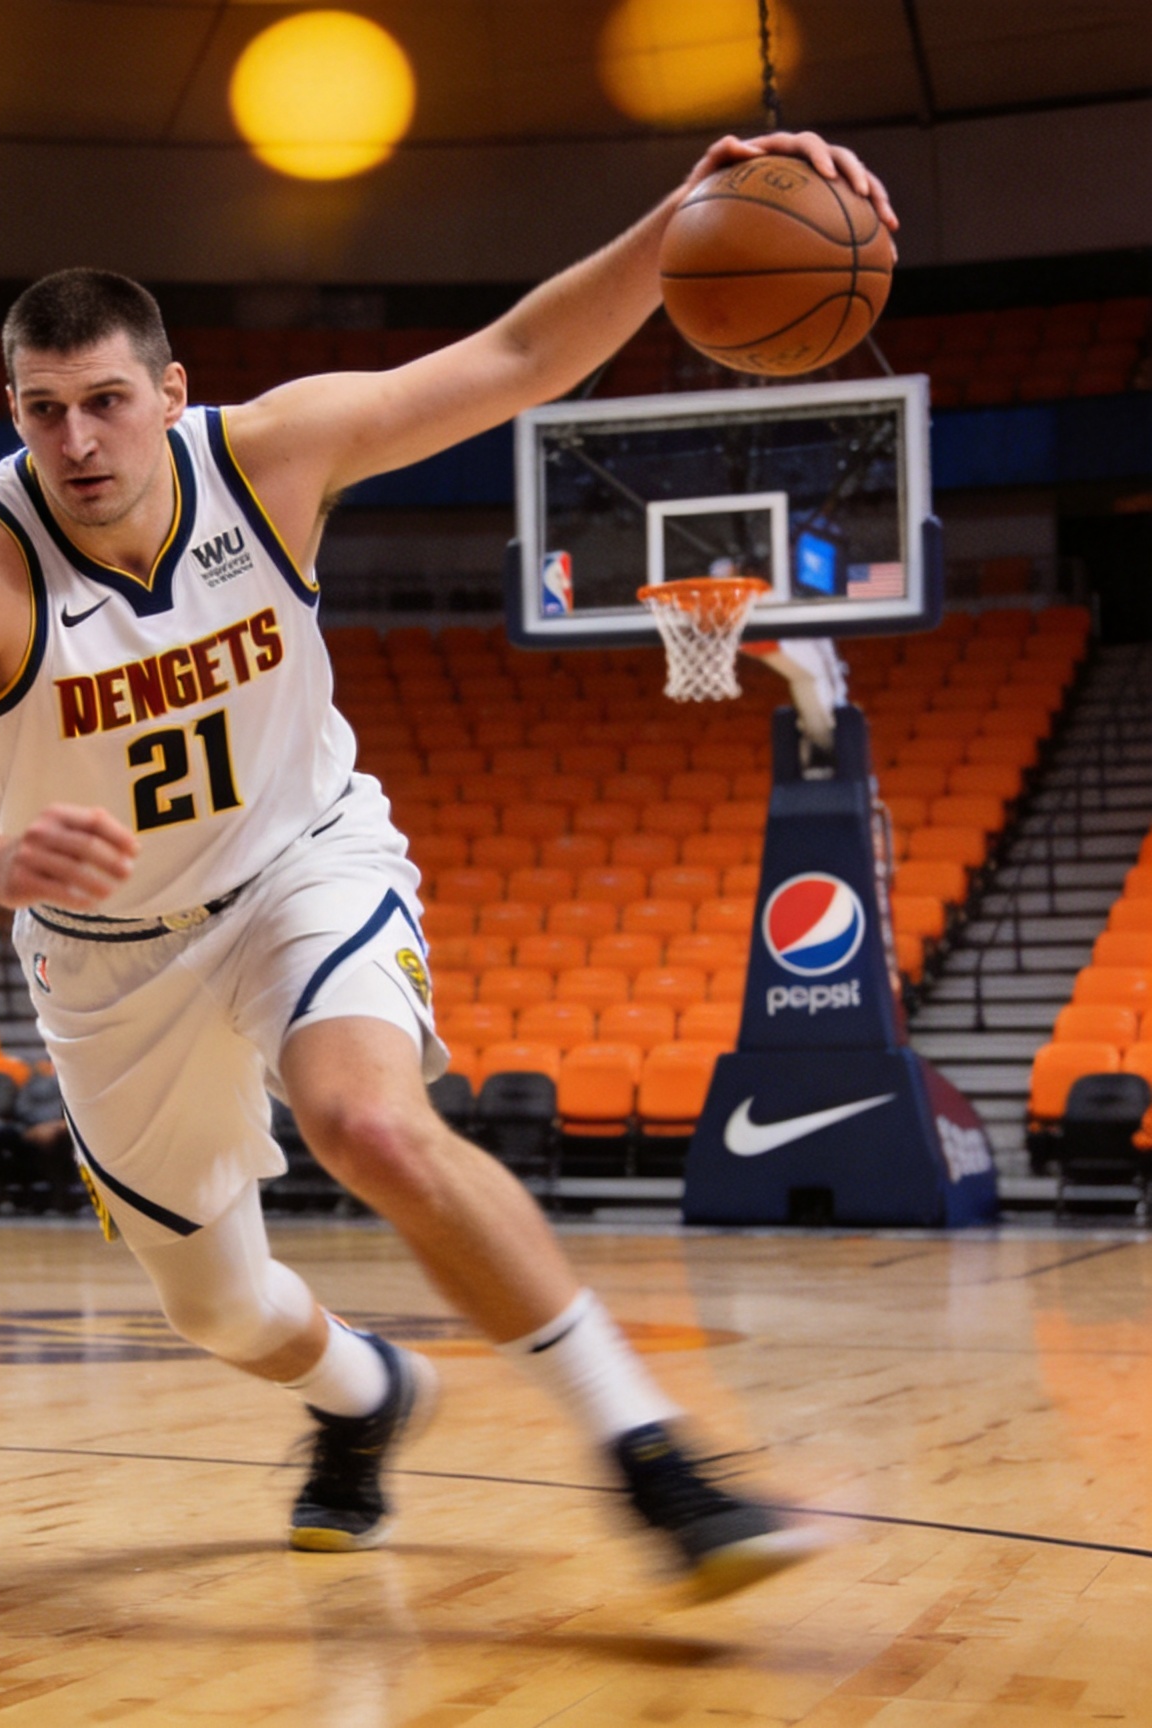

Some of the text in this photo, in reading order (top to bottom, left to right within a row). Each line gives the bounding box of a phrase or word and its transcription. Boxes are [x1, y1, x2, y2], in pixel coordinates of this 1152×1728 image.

[191, 525, 245, 570] WU
[52, 606, 284, 740] DENGETS
[126, 707, 245, 836] 21
[765, 978, 862, 1017] pepsi
